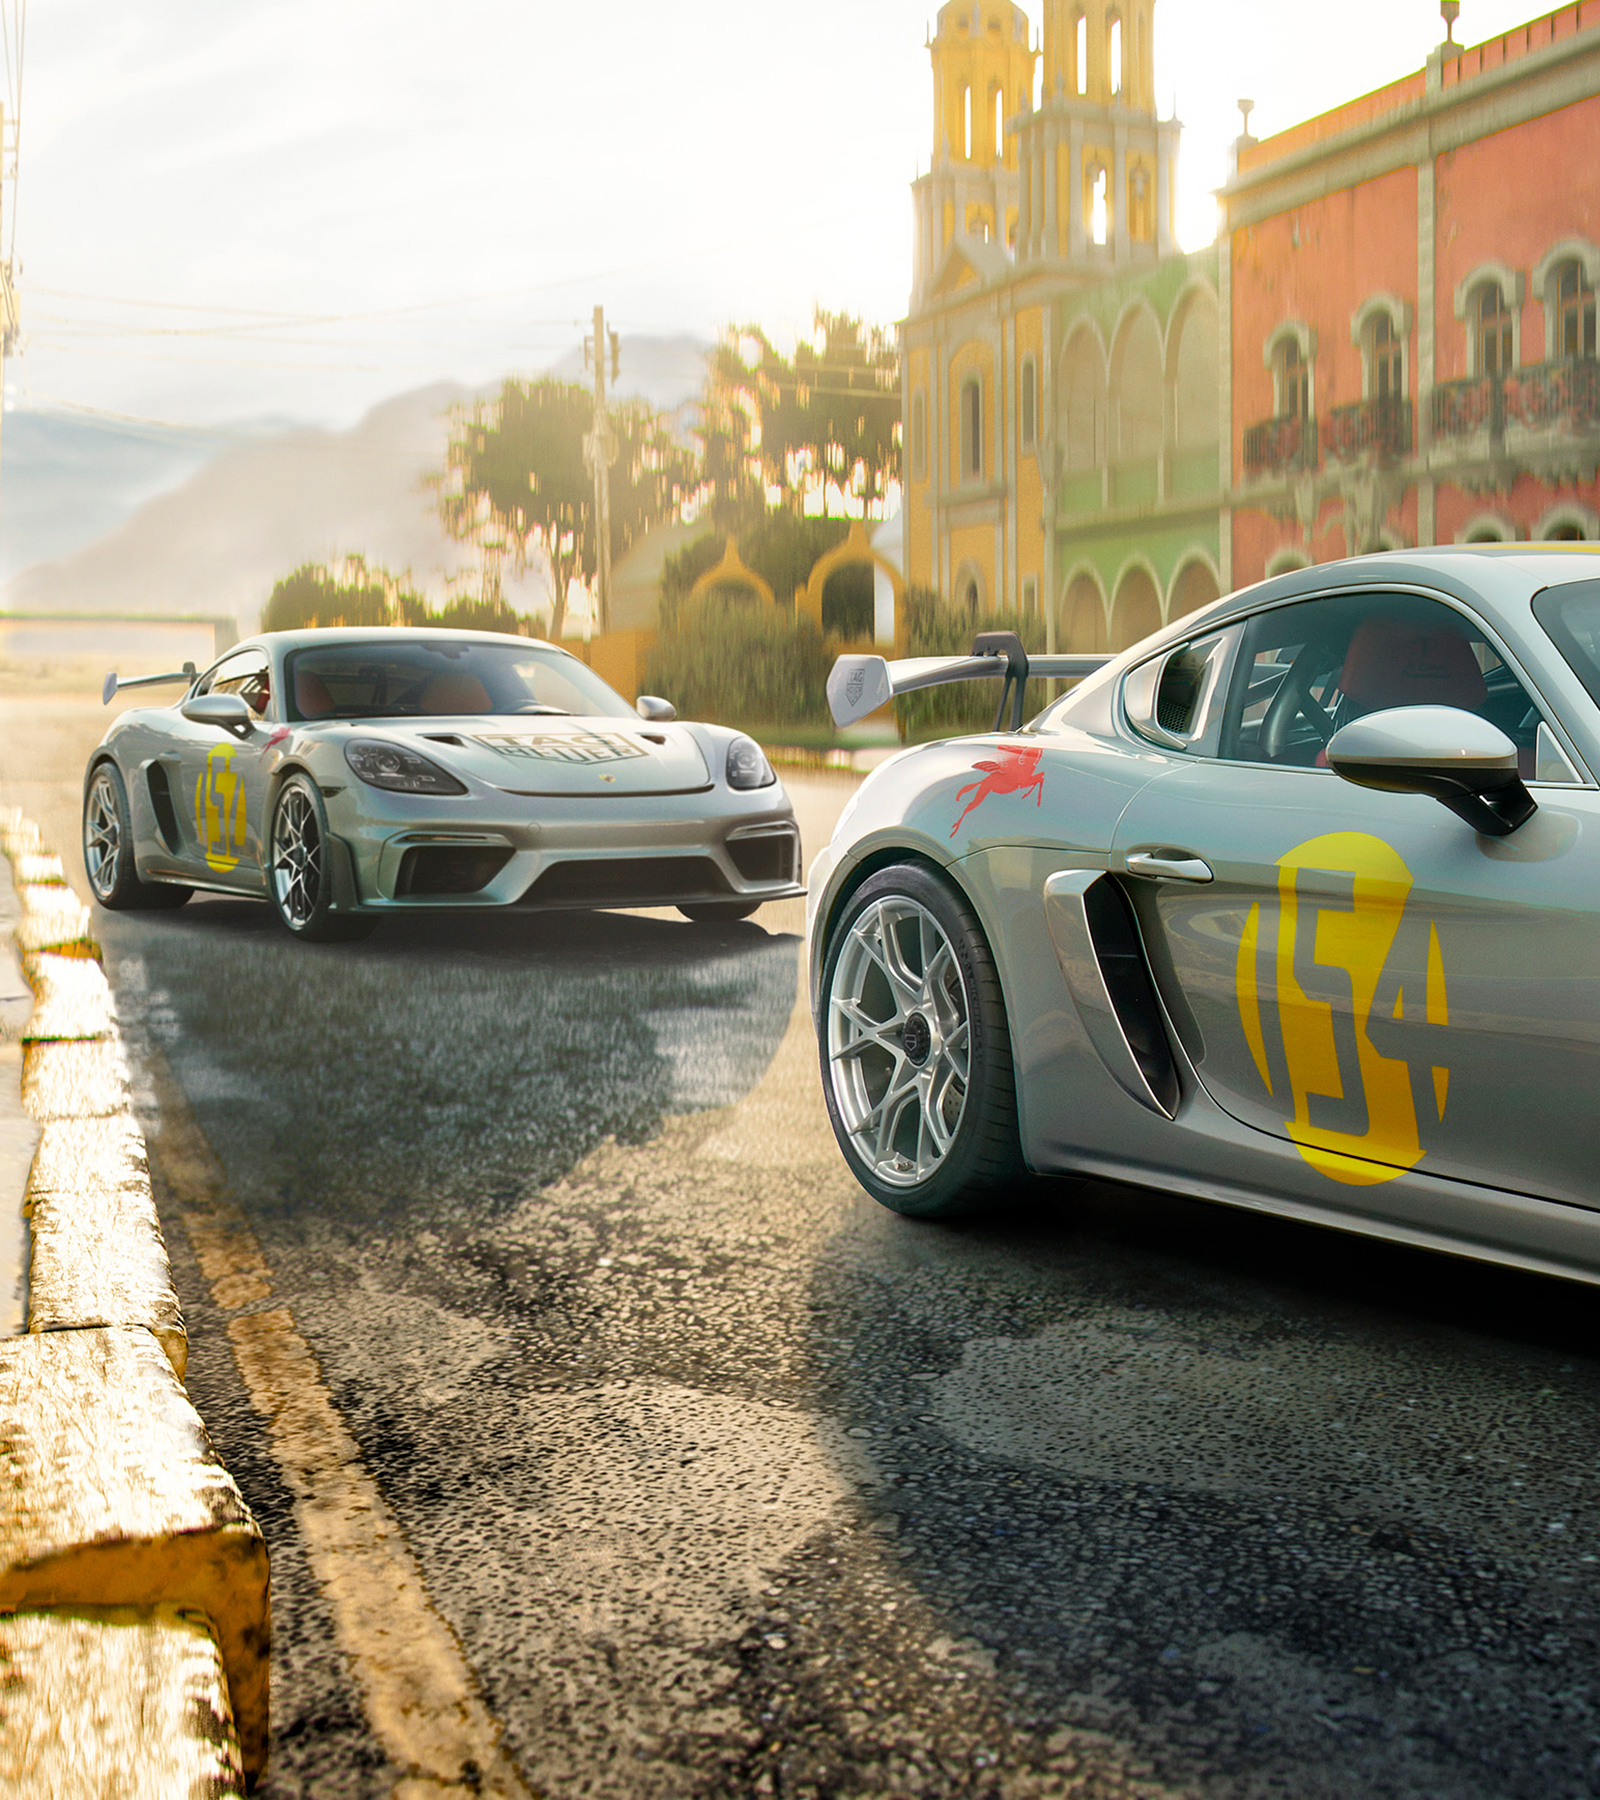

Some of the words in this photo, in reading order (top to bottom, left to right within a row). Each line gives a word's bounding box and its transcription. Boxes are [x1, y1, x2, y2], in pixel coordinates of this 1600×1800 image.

[486, 734, 617, 746] TAG
[501, 746, 638, 762] HEUER
[1245, 858, 1450, 1160] 154
